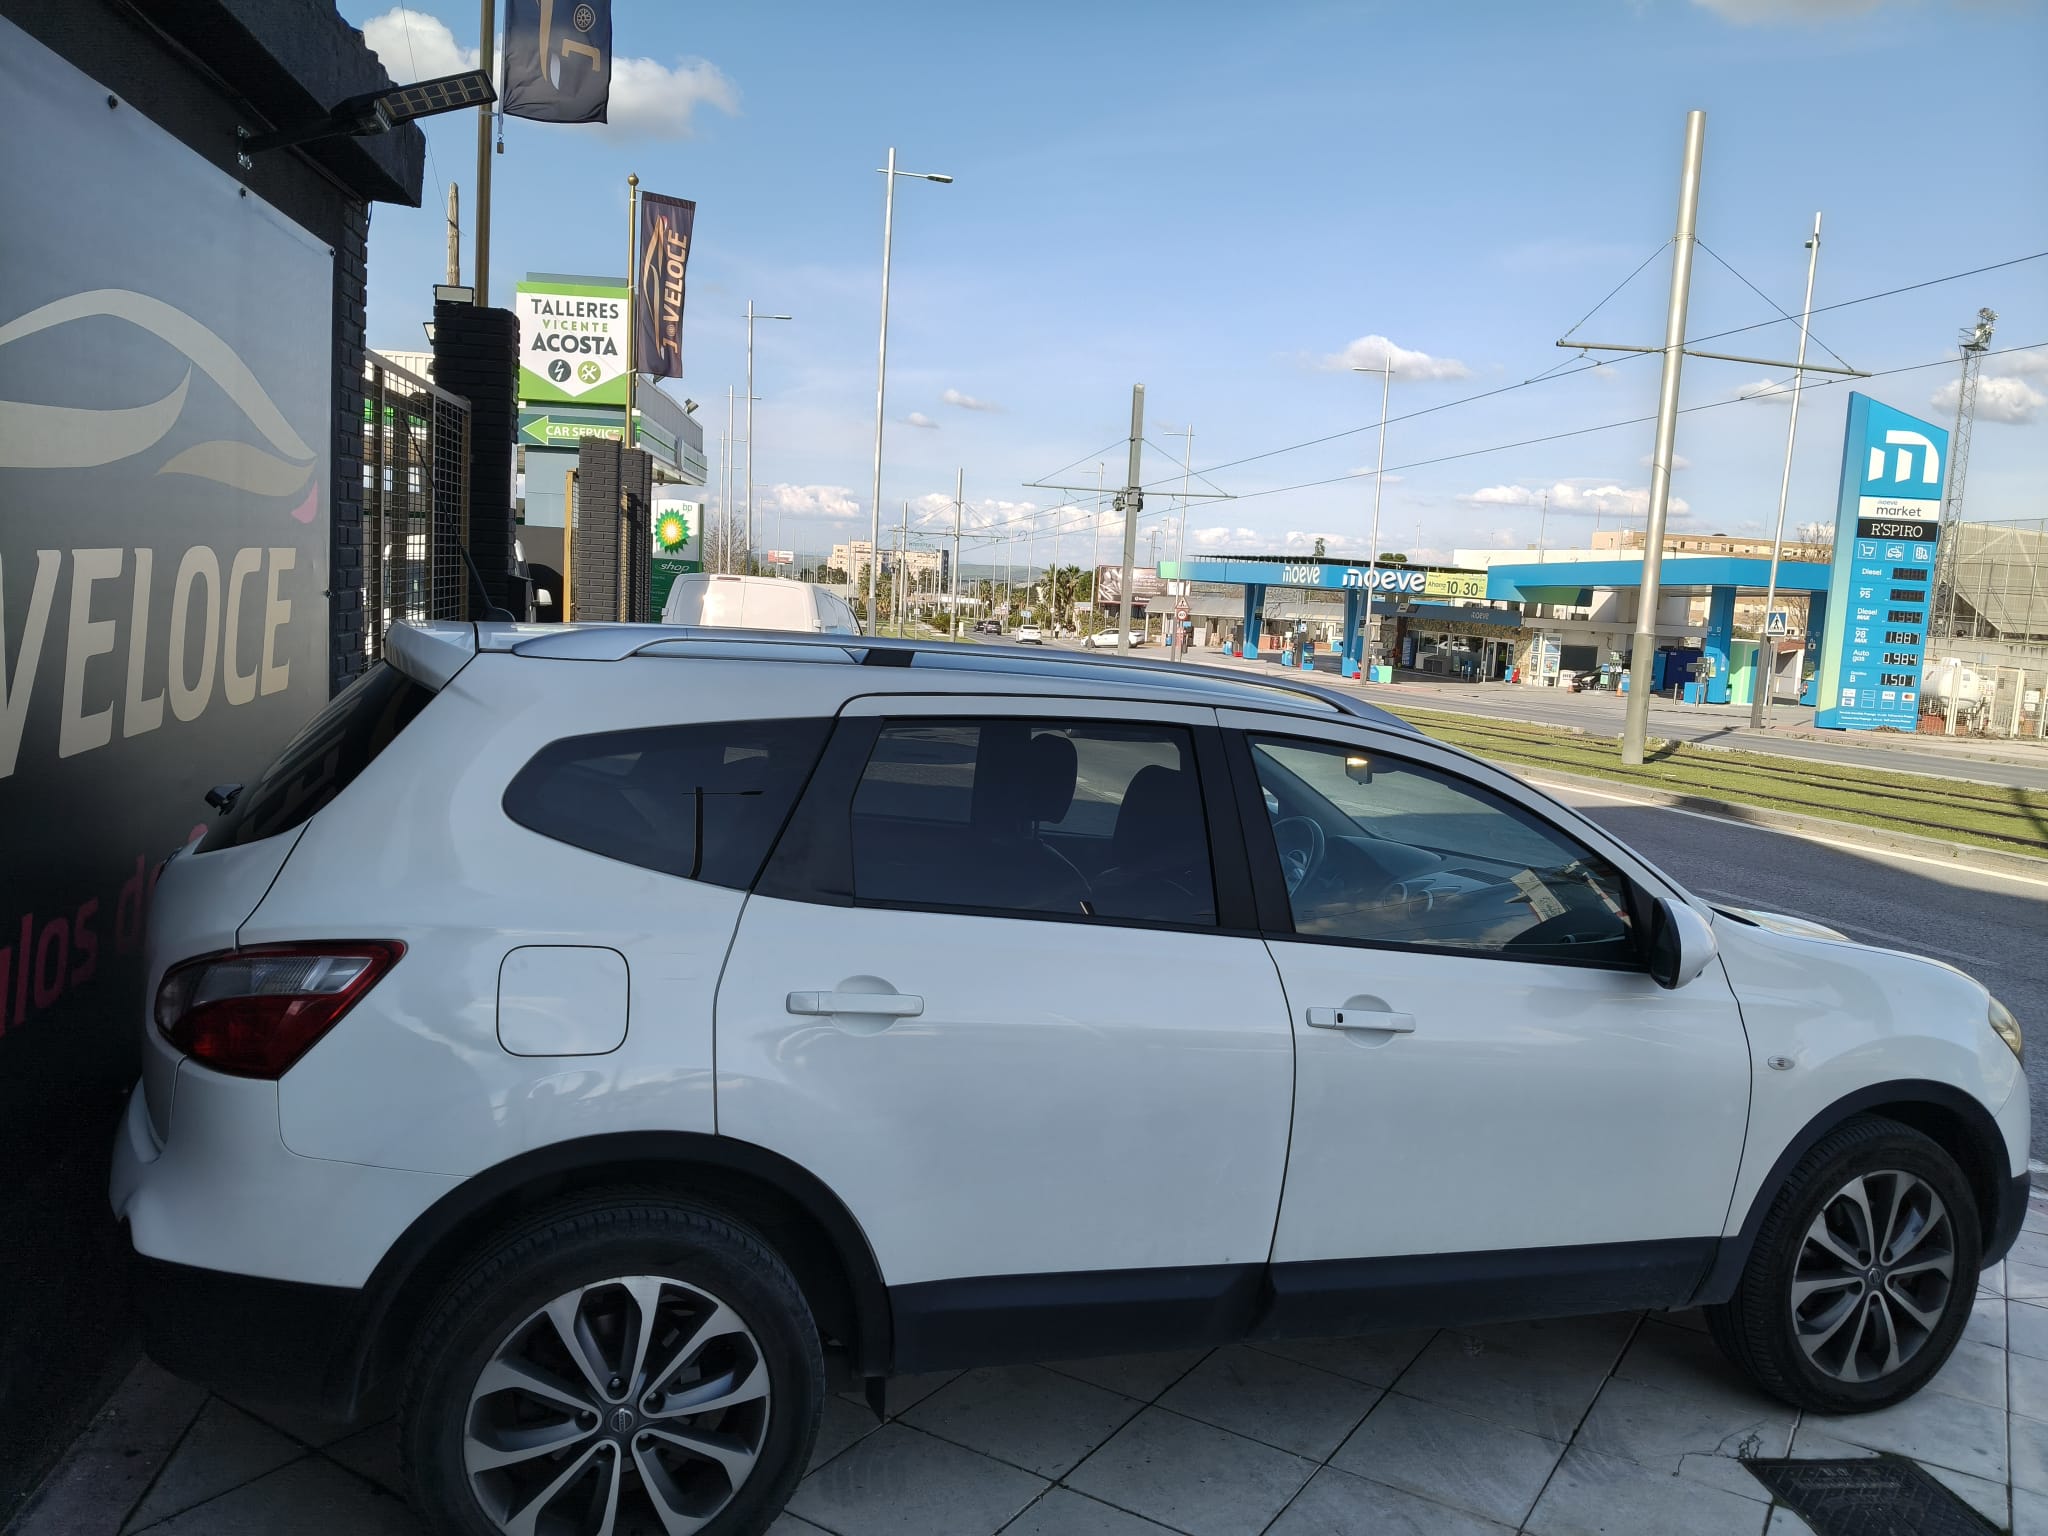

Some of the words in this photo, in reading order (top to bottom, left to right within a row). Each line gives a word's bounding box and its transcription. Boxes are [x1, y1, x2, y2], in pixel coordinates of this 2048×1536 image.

[531, 298, 619, 319] TALLERES
[542, 319, 608, 332] VICENTE
[531, 332, 618, 356] ACOSTA
[546, 425, 570, 437] CAR
[682, 503, 693, 512] bp
[1876, 506, 1922, 517] market
[1871, 523, 1923, 538] R'SPIRO
[661, 562, 690, 573] shop
[1862, 568, 1882, 576] Diesel
[1282, 566, 1320, 585] moeve
[1342, 569, 1426, 592] moeve
[1447, 581, 1458, 594] 10
[1463, 582, 1478, 596] 30
[1860, 590, 1871, 599] 95
[1855, 630, 1866, 638] 98
